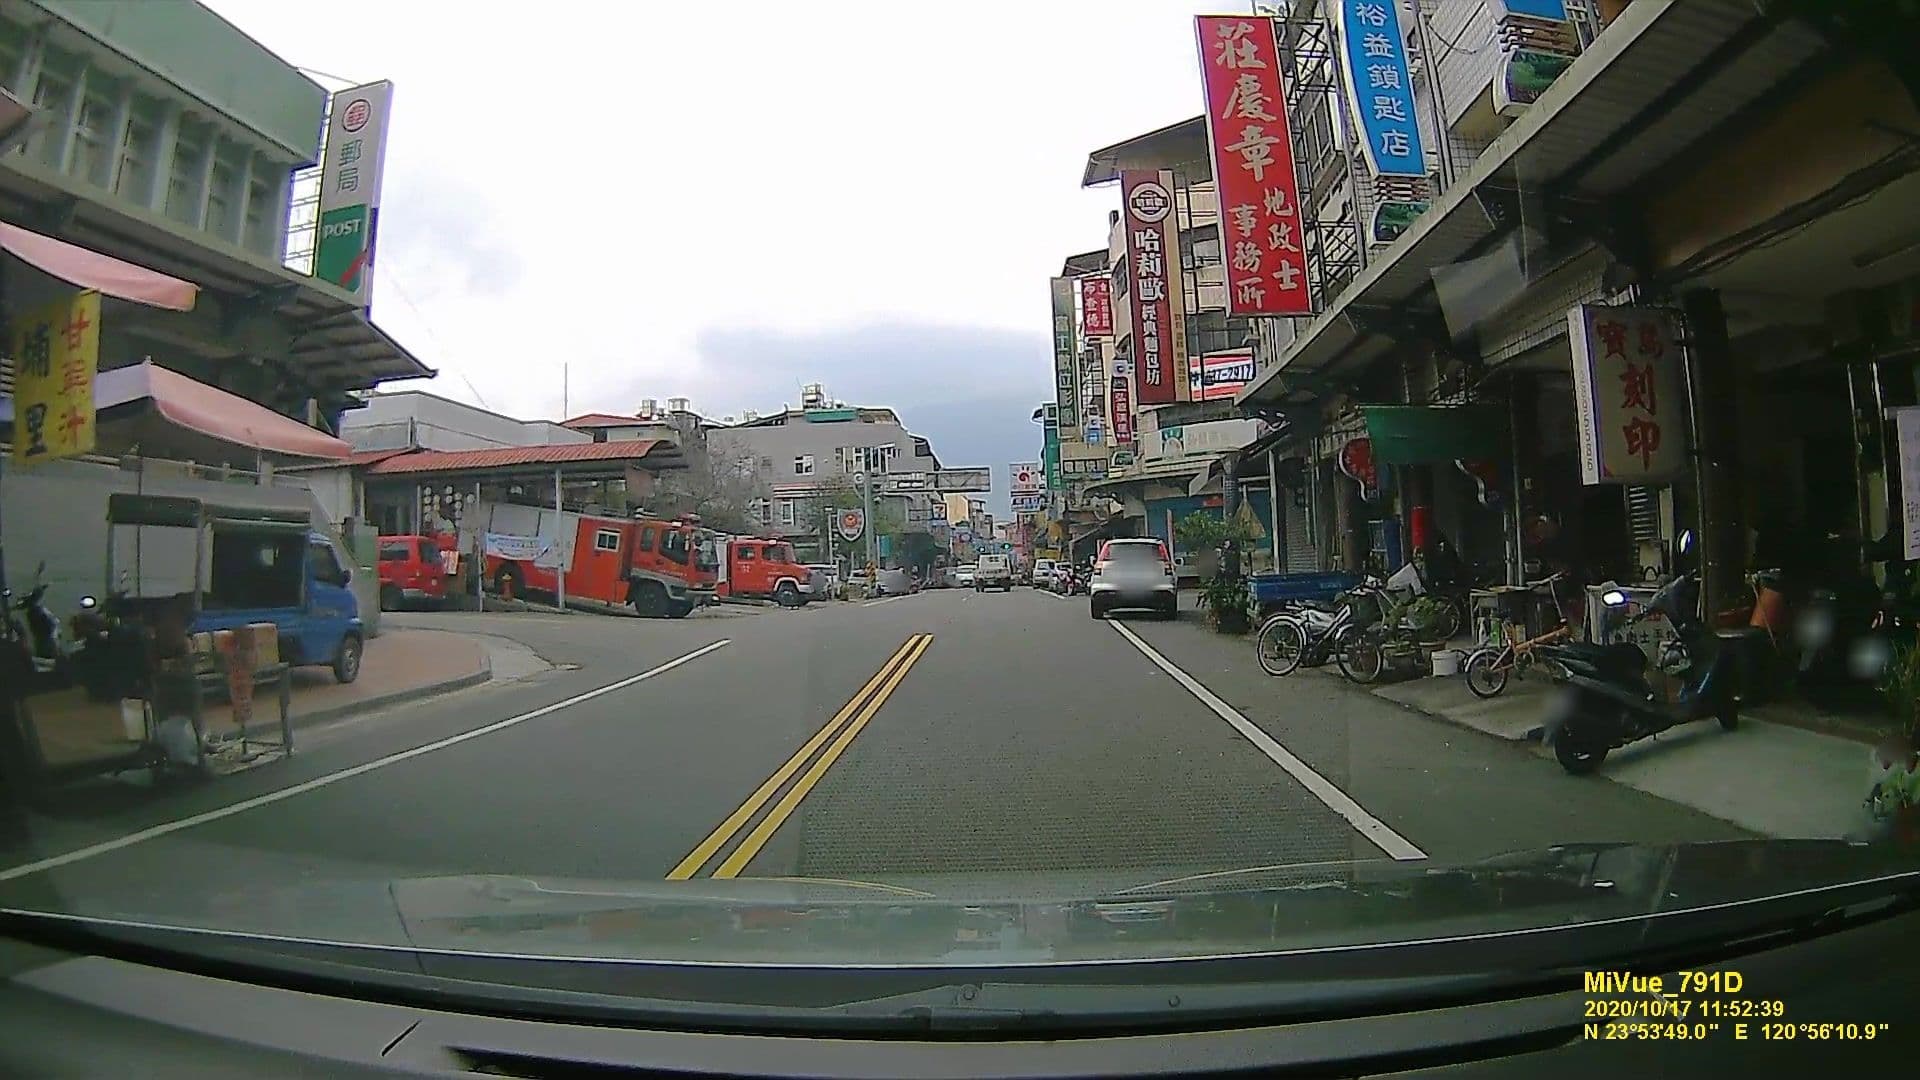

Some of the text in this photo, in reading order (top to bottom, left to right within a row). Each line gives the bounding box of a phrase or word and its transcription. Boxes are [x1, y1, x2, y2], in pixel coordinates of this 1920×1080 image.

[1356, 2, 1412, 157] 裕益鎖匙店
[336, 139, 363, 193] 郵局
[323, 218, 361, 239] POST
[1229, 203, 1266, 310] 事務所
[1263, 187, 1300, 291] 地政士
